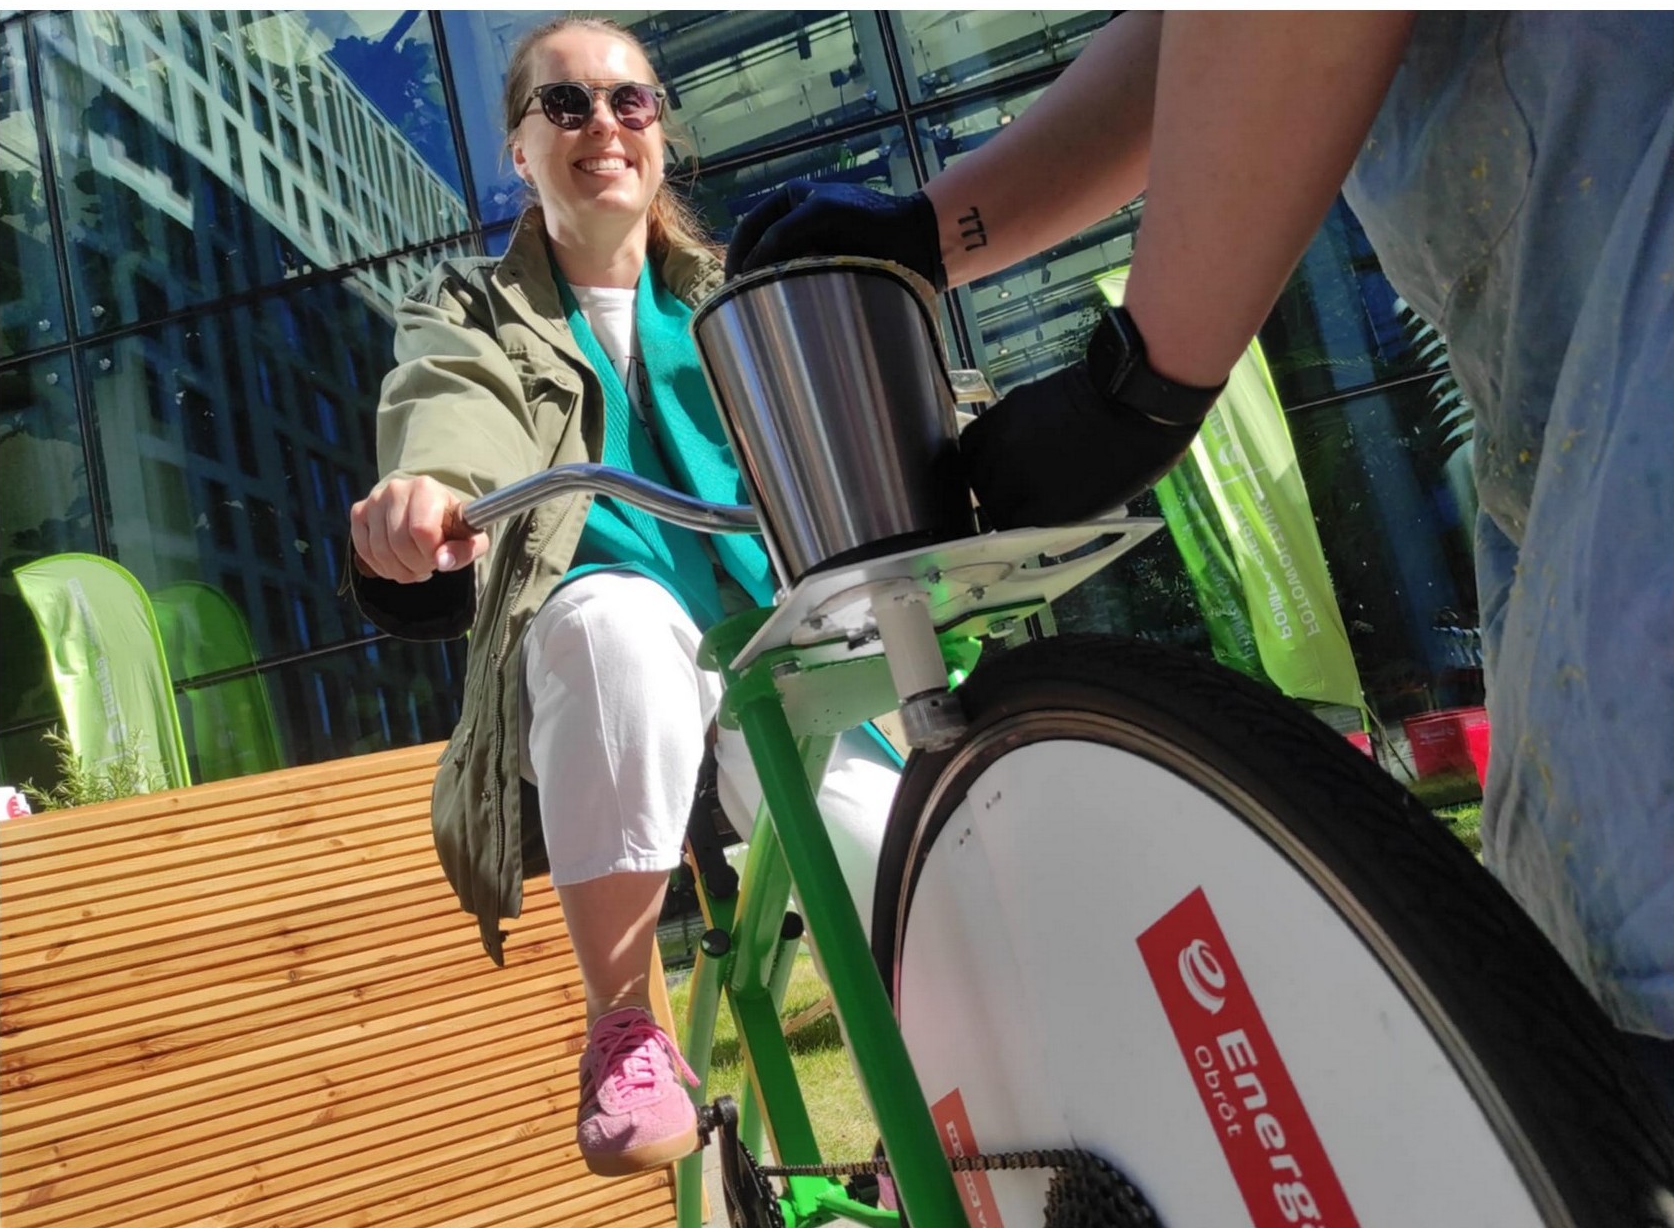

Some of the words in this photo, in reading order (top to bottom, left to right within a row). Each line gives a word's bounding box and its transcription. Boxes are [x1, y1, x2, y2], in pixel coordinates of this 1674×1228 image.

[957, 206, 988, 252] 777
[1194, 1045, 1242, 1137] Obrót
[1217, 1029, 1325, 1228] Energ
